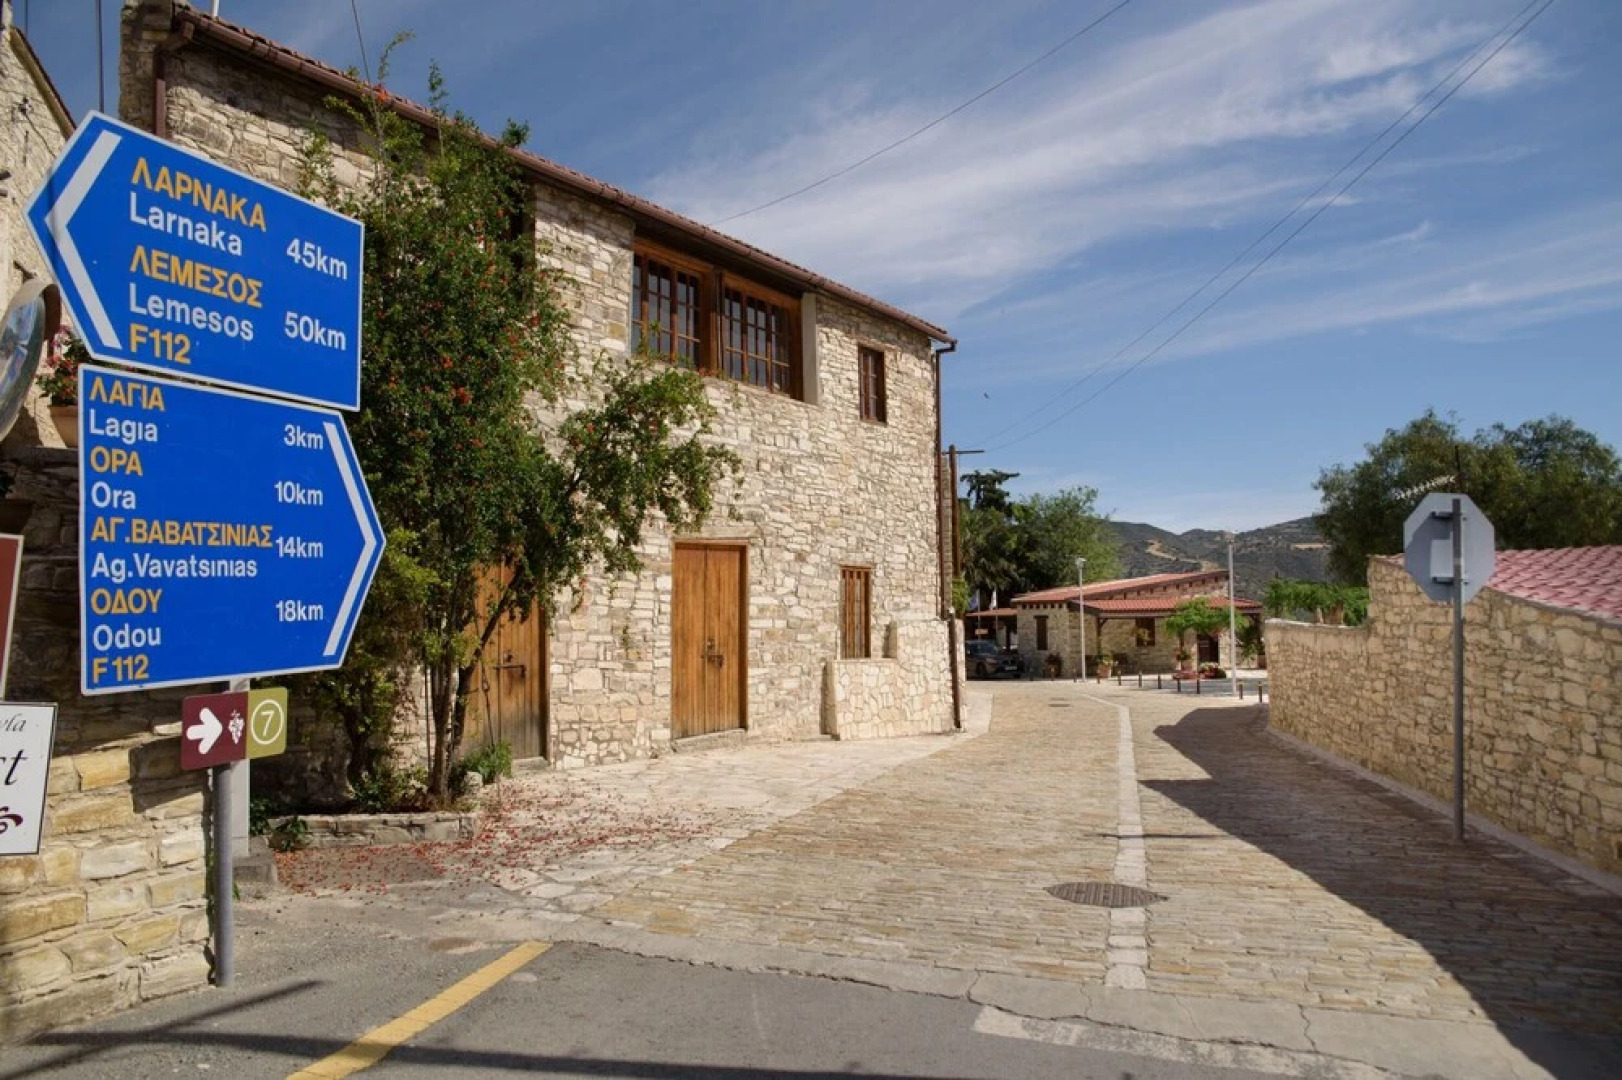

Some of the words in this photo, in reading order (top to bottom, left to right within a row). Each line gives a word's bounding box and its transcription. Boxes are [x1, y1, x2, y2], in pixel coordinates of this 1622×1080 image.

[131, 156, 267, 232] ΛΑΡΝΑΚΑ
[129, 192, 242, 256] Larnaka
[286, 239, 348, 280] 45km
[130, 246, 263, 308] ΛΕΜΕΣΟΣ
[129, 283, 254, 341] Lemesos
[129, 323, 191, 364] F112
[284, 311, 346, 350] 50km
[89, 377, 165, 411] ΛΑΓΙΑ
[283, 425, 324, 450] 3km
[90, 446, 143, 476] ΟΡΑ
[91, 481, 136, 510] Ora
[274, 481, 324, 506] 10km
[275, 537, 324, 558] 14km
[90, 588, 163, 615] ΟΔΟΥ
[275, 599, 324, 622] 18km
[93, 624, 162, 651] Odou
[261, 709, 275, 737] 7
